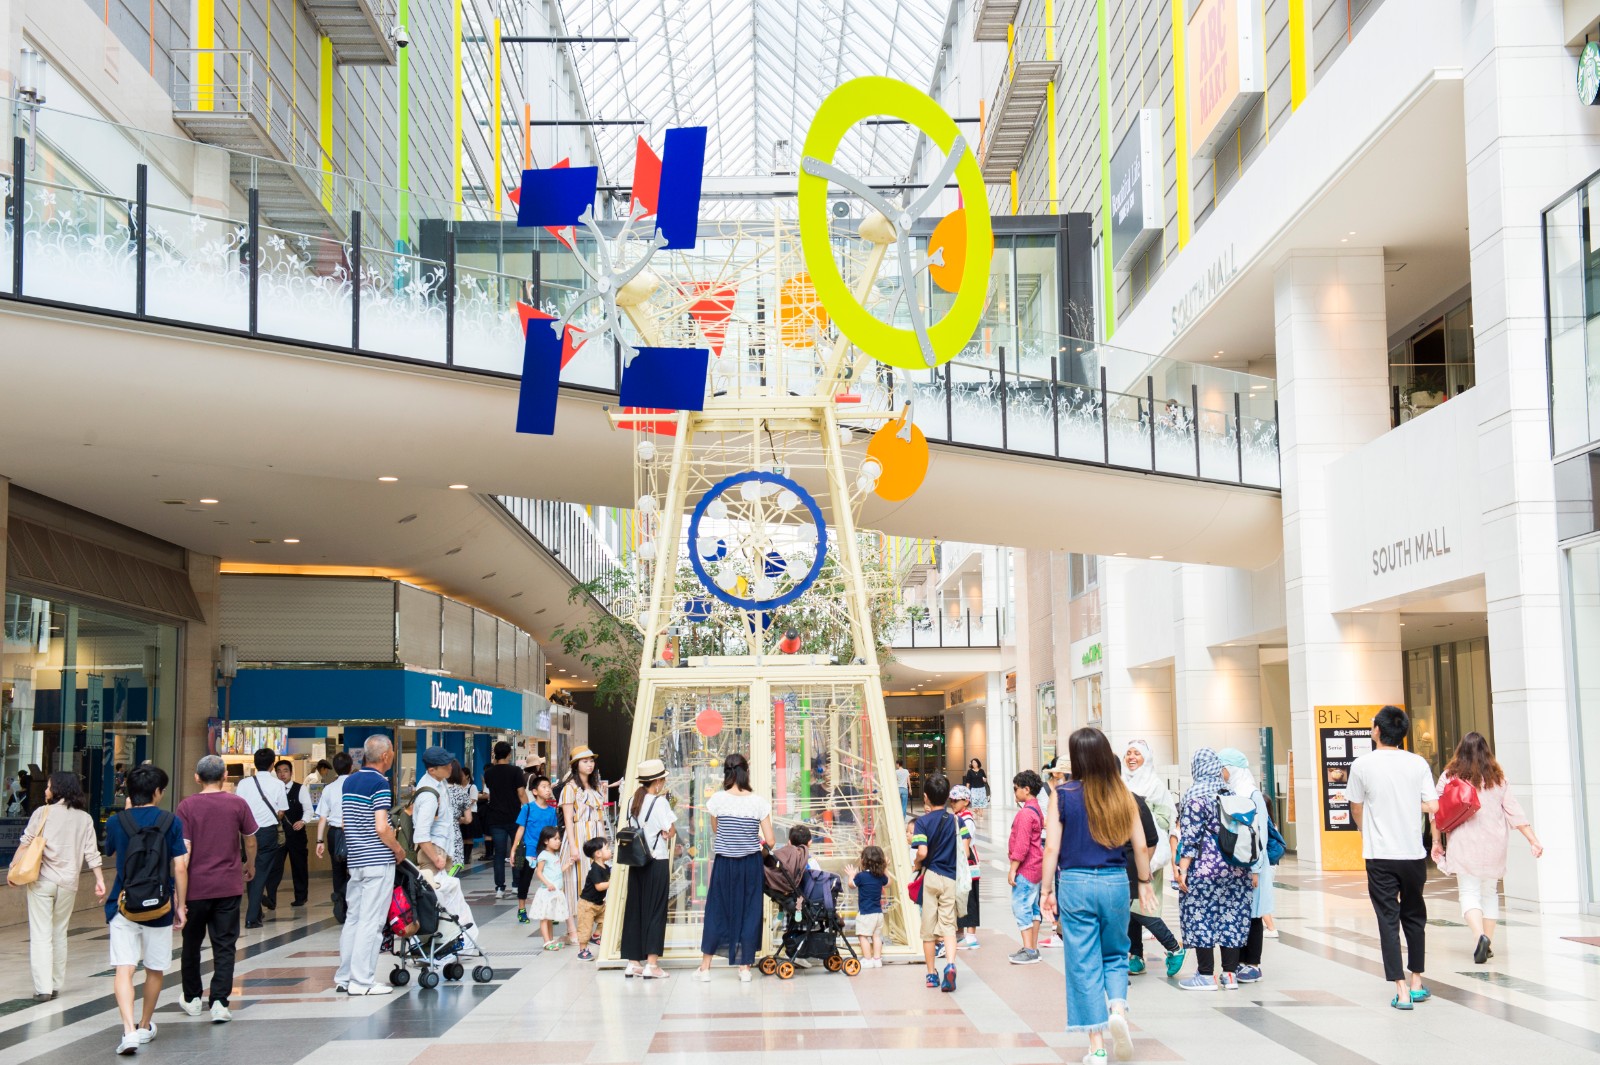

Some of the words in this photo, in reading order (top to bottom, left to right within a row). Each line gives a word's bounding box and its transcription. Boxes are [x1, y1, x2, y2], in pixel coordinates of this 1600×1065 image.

[1199, 0, 1227, 82] ABC
[1199, 50, 1228, 125] MART
[1172, 274, 1205, 337] SOUTH
[1208, 242, 1238, 301] MALL
[1372, 537, 1412, 576] SOUTH
[1415, 526, 1451, 563] MALL
[431, 680, 458, 718] Dipper
[458, 685, 472, 713] Dan
[472, 688, 493, 716] CREPE
[1318, 709, 1341, 724] B1F
